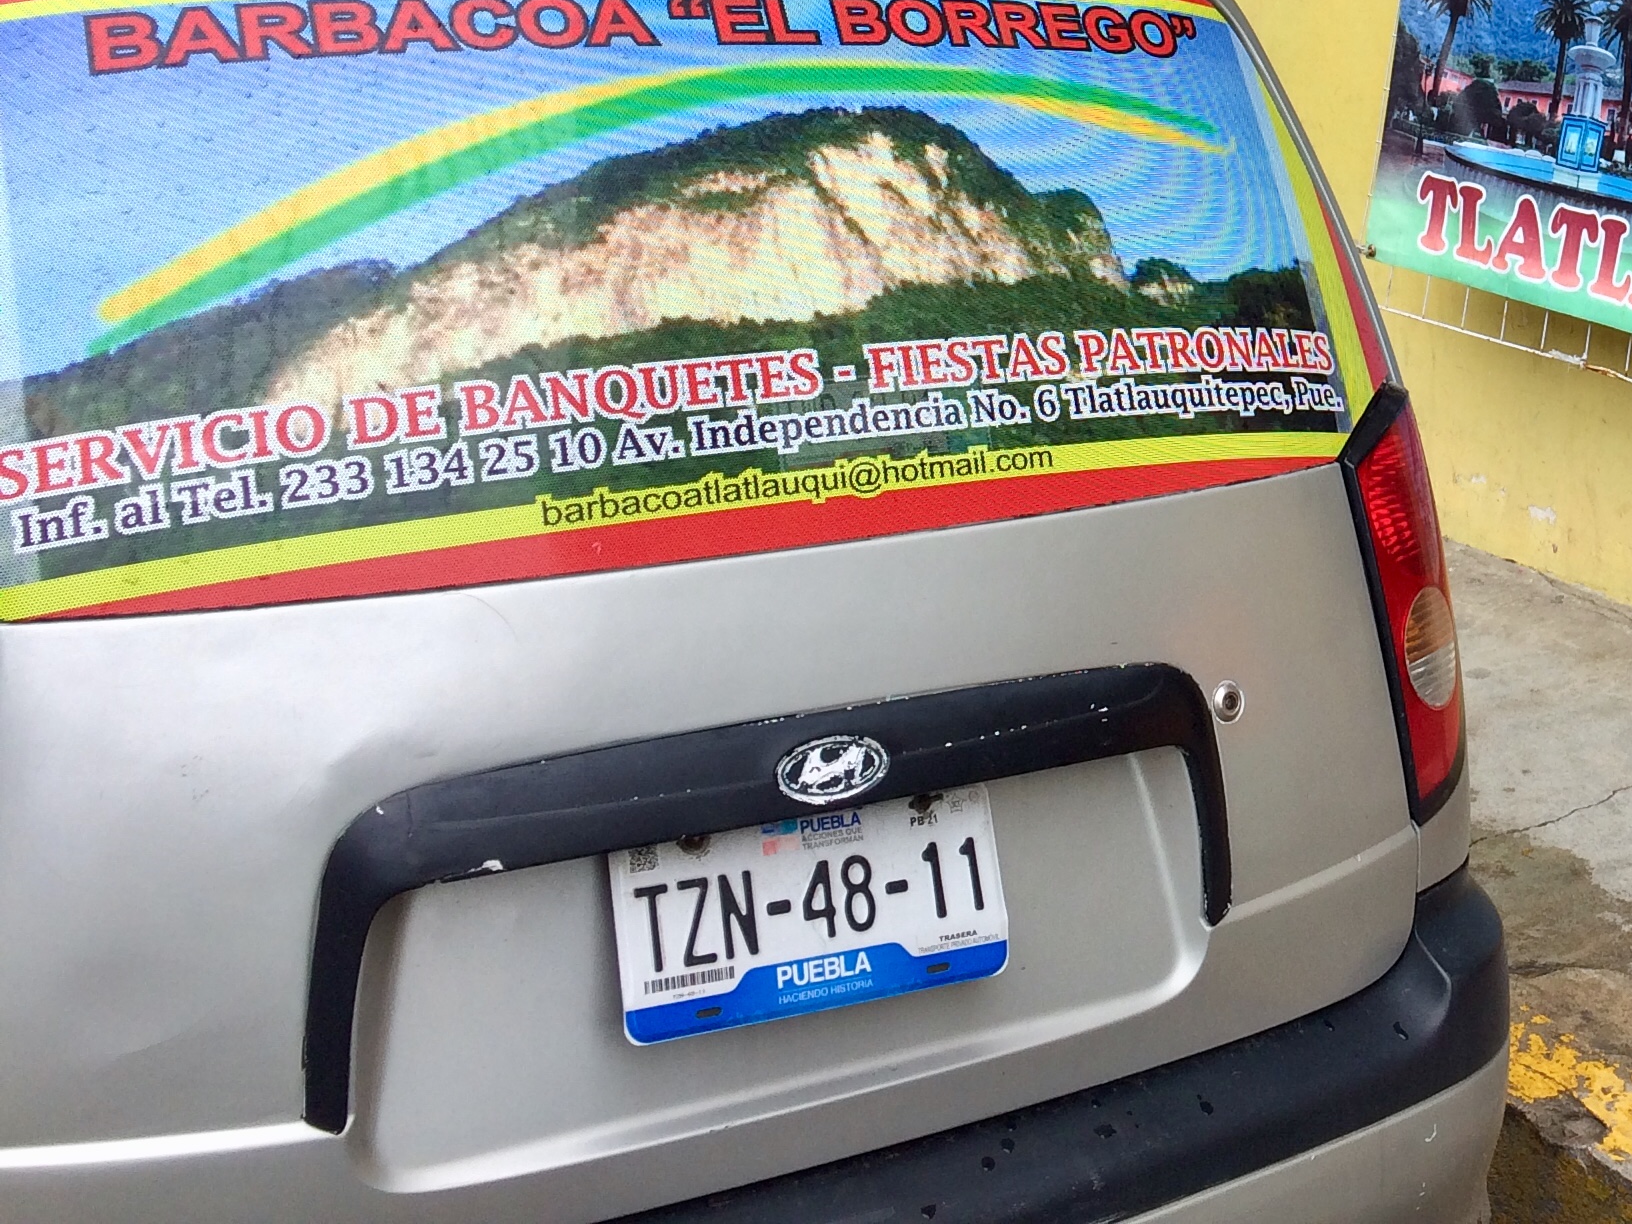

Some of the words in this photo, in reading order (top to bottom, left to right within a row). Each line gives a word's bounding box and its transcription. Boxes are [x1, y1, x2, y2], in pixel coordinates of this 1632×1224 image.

[0, 403, 327, 500] SERVICIO
[348, 390, 442, 448] DE
[459, 352, 819, 434] BANQUETES
[867, 334, 1068, 388] FIESTAS
[1077, 329, 1334, 374] PATRONALES
[19, 500, 103, 549] Inf.
[120, 488, 163, 530] al
[178, 473, 269, 520] Tel.
[284, 460, 369, 504] 233
[389, 448, 469, 490] 134
[484, 440, 536, 476] 25
[554, 431, 603, 468] 10
[617, 428, 681, 461] Av.
[697, 398, 962, 451] Independencia
[972, 391, 1027, 423] No.
[1037, 388, 1057, 417] 6
[1070, 382, 1291, 416] Tlatlauquitepec,
[1296, 381, 1342, 411] Pue.
[541, 449, 1053, 526] barbacoatlatlauqui@hotmail.com
[801, 812, 861, 833] PUEBLA
[801, 829, 846, 842] ACCIONES
[848, 826, 862, 836] QUE
[802, 835, 864, 850] TRANSFORMAN
[634, 836, 984, 973] TZN-48-11
[939, 930, 977, 942] TRASERA
[776, 951, 872, 989] PUEBLA
[778, 988, 828, 1005] HACIENDO
[830, 979, 873, 995] HISTORIA
